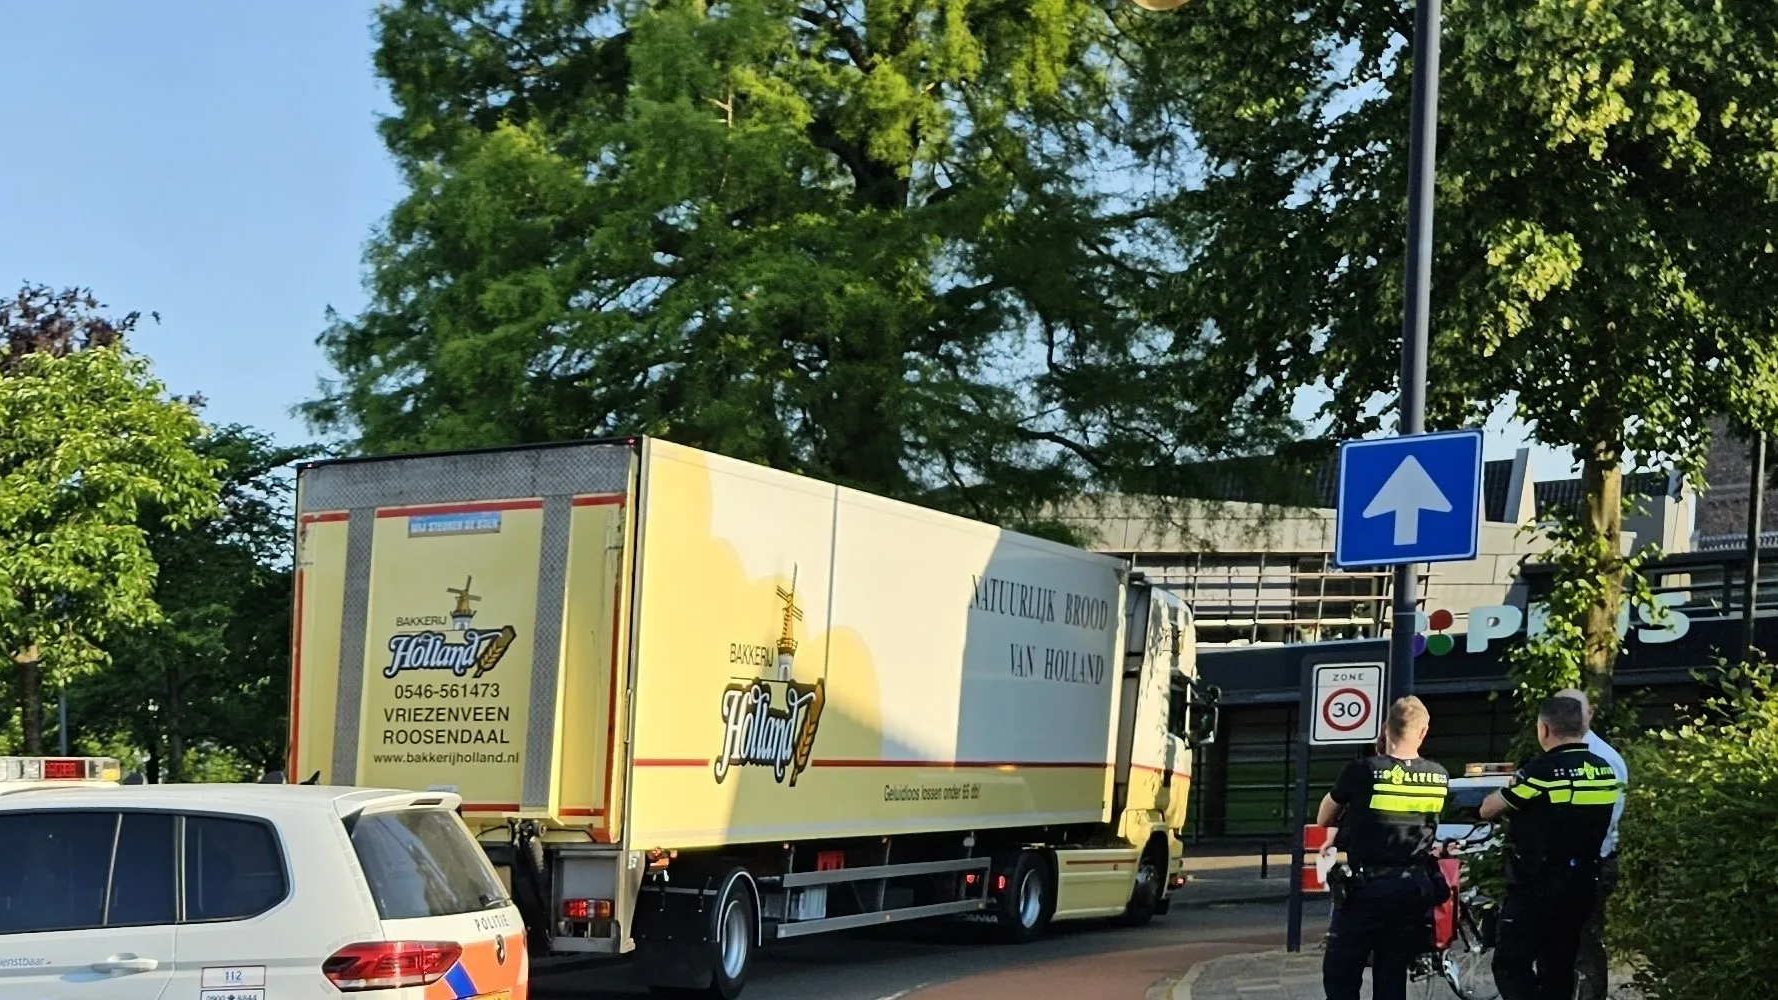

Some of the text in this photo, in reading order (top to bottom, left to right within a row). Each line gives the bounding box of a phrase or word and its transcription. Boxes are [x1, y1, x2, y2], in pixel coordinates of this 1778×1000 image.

[970, 574, 1108, 630] NATUURLIJK BROOD
[396, 616, 447, 627] BAKKERIJ
[1466, 591, 1691, 653] PS
[384, 631, 503, 677] Holland
[730, 643, 774, 667] BAKKERIJ
[1011, 643, 1104, 685] VAN HOLLAND
[1332, 673, 1365, 682] ZONE
[395, 682, 500, 699] 0546-561473
[384, 706, 510, 723] VRIEZENVEEN
[1332, 702, 1361, 718] 30
[383, 729, 510, 744] ROOSENDAAL
[714, 684, 816, 777] Holland
[373, 752, 520, 766] www.bakkerijholland.nl
[474, 914, 510, 932] POLITIE
[225, 970, 242, 981] 112
